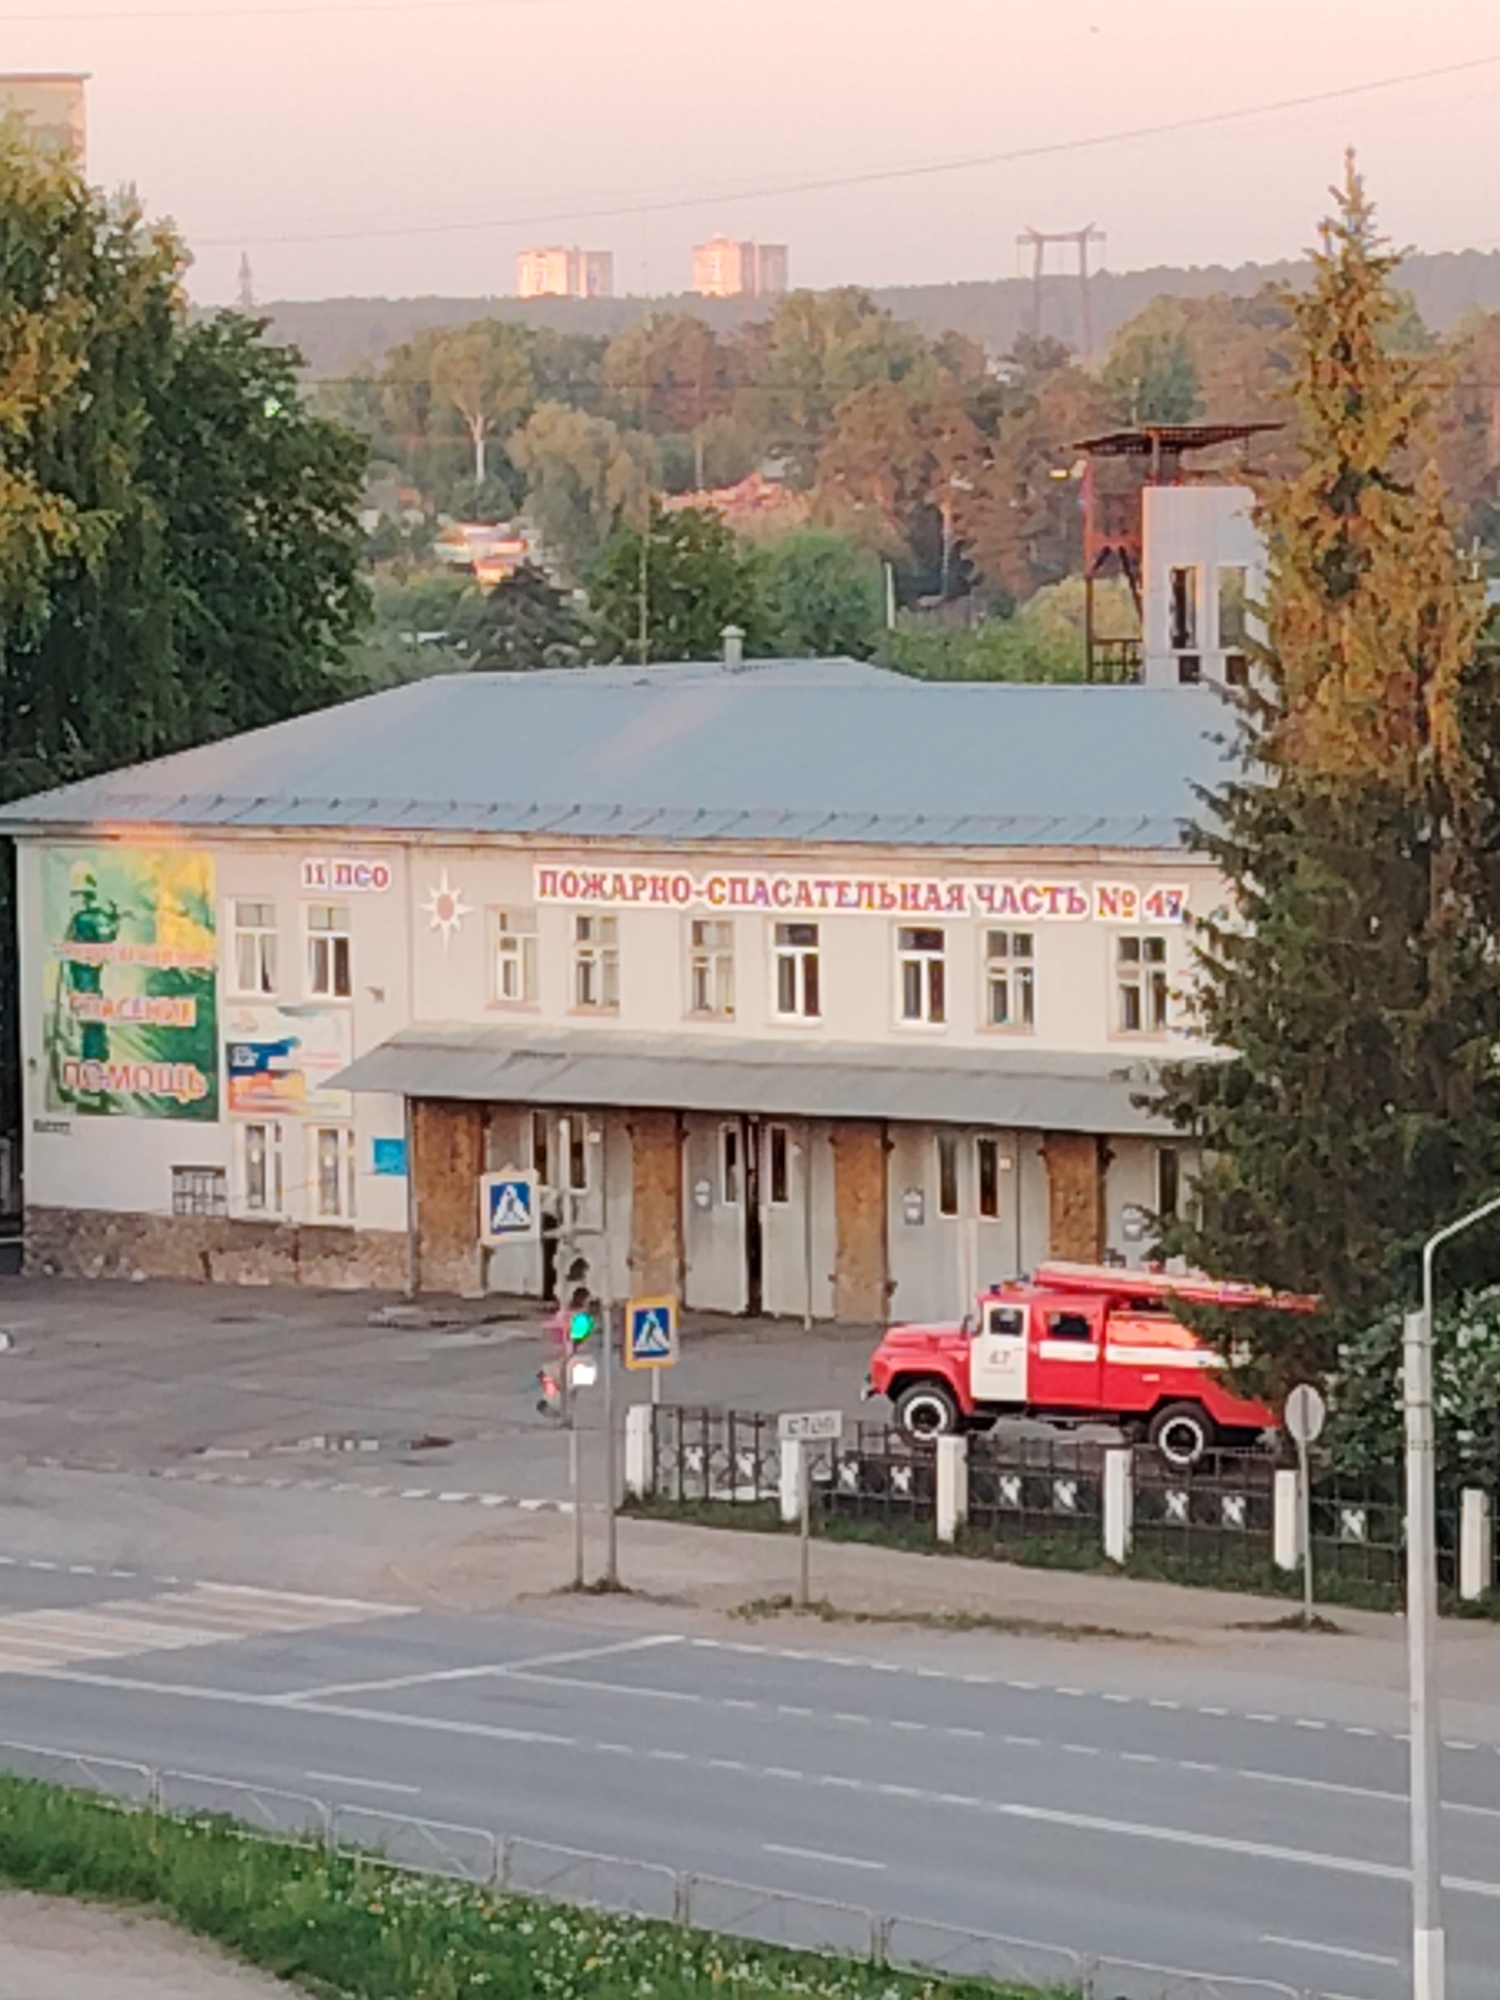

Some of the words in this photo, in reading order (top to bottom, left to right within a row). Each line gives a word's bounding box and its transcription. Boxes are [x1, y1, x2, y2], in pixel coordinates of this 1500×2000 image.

[304, 863, 326, 885] 11
[334, 863, 389, 888] ПСО
[538, 869, 967, 911] ПОЖАРНО-СПАСАТЕЛЬНАЯ
[974, 883, 1087, 914] ЧАСТЬ
[1097, 886, 1137, 917] №
[1144, 889, 1184, 918] 47
[63, 1062, 206, 1096] ПОМОЩЬ
